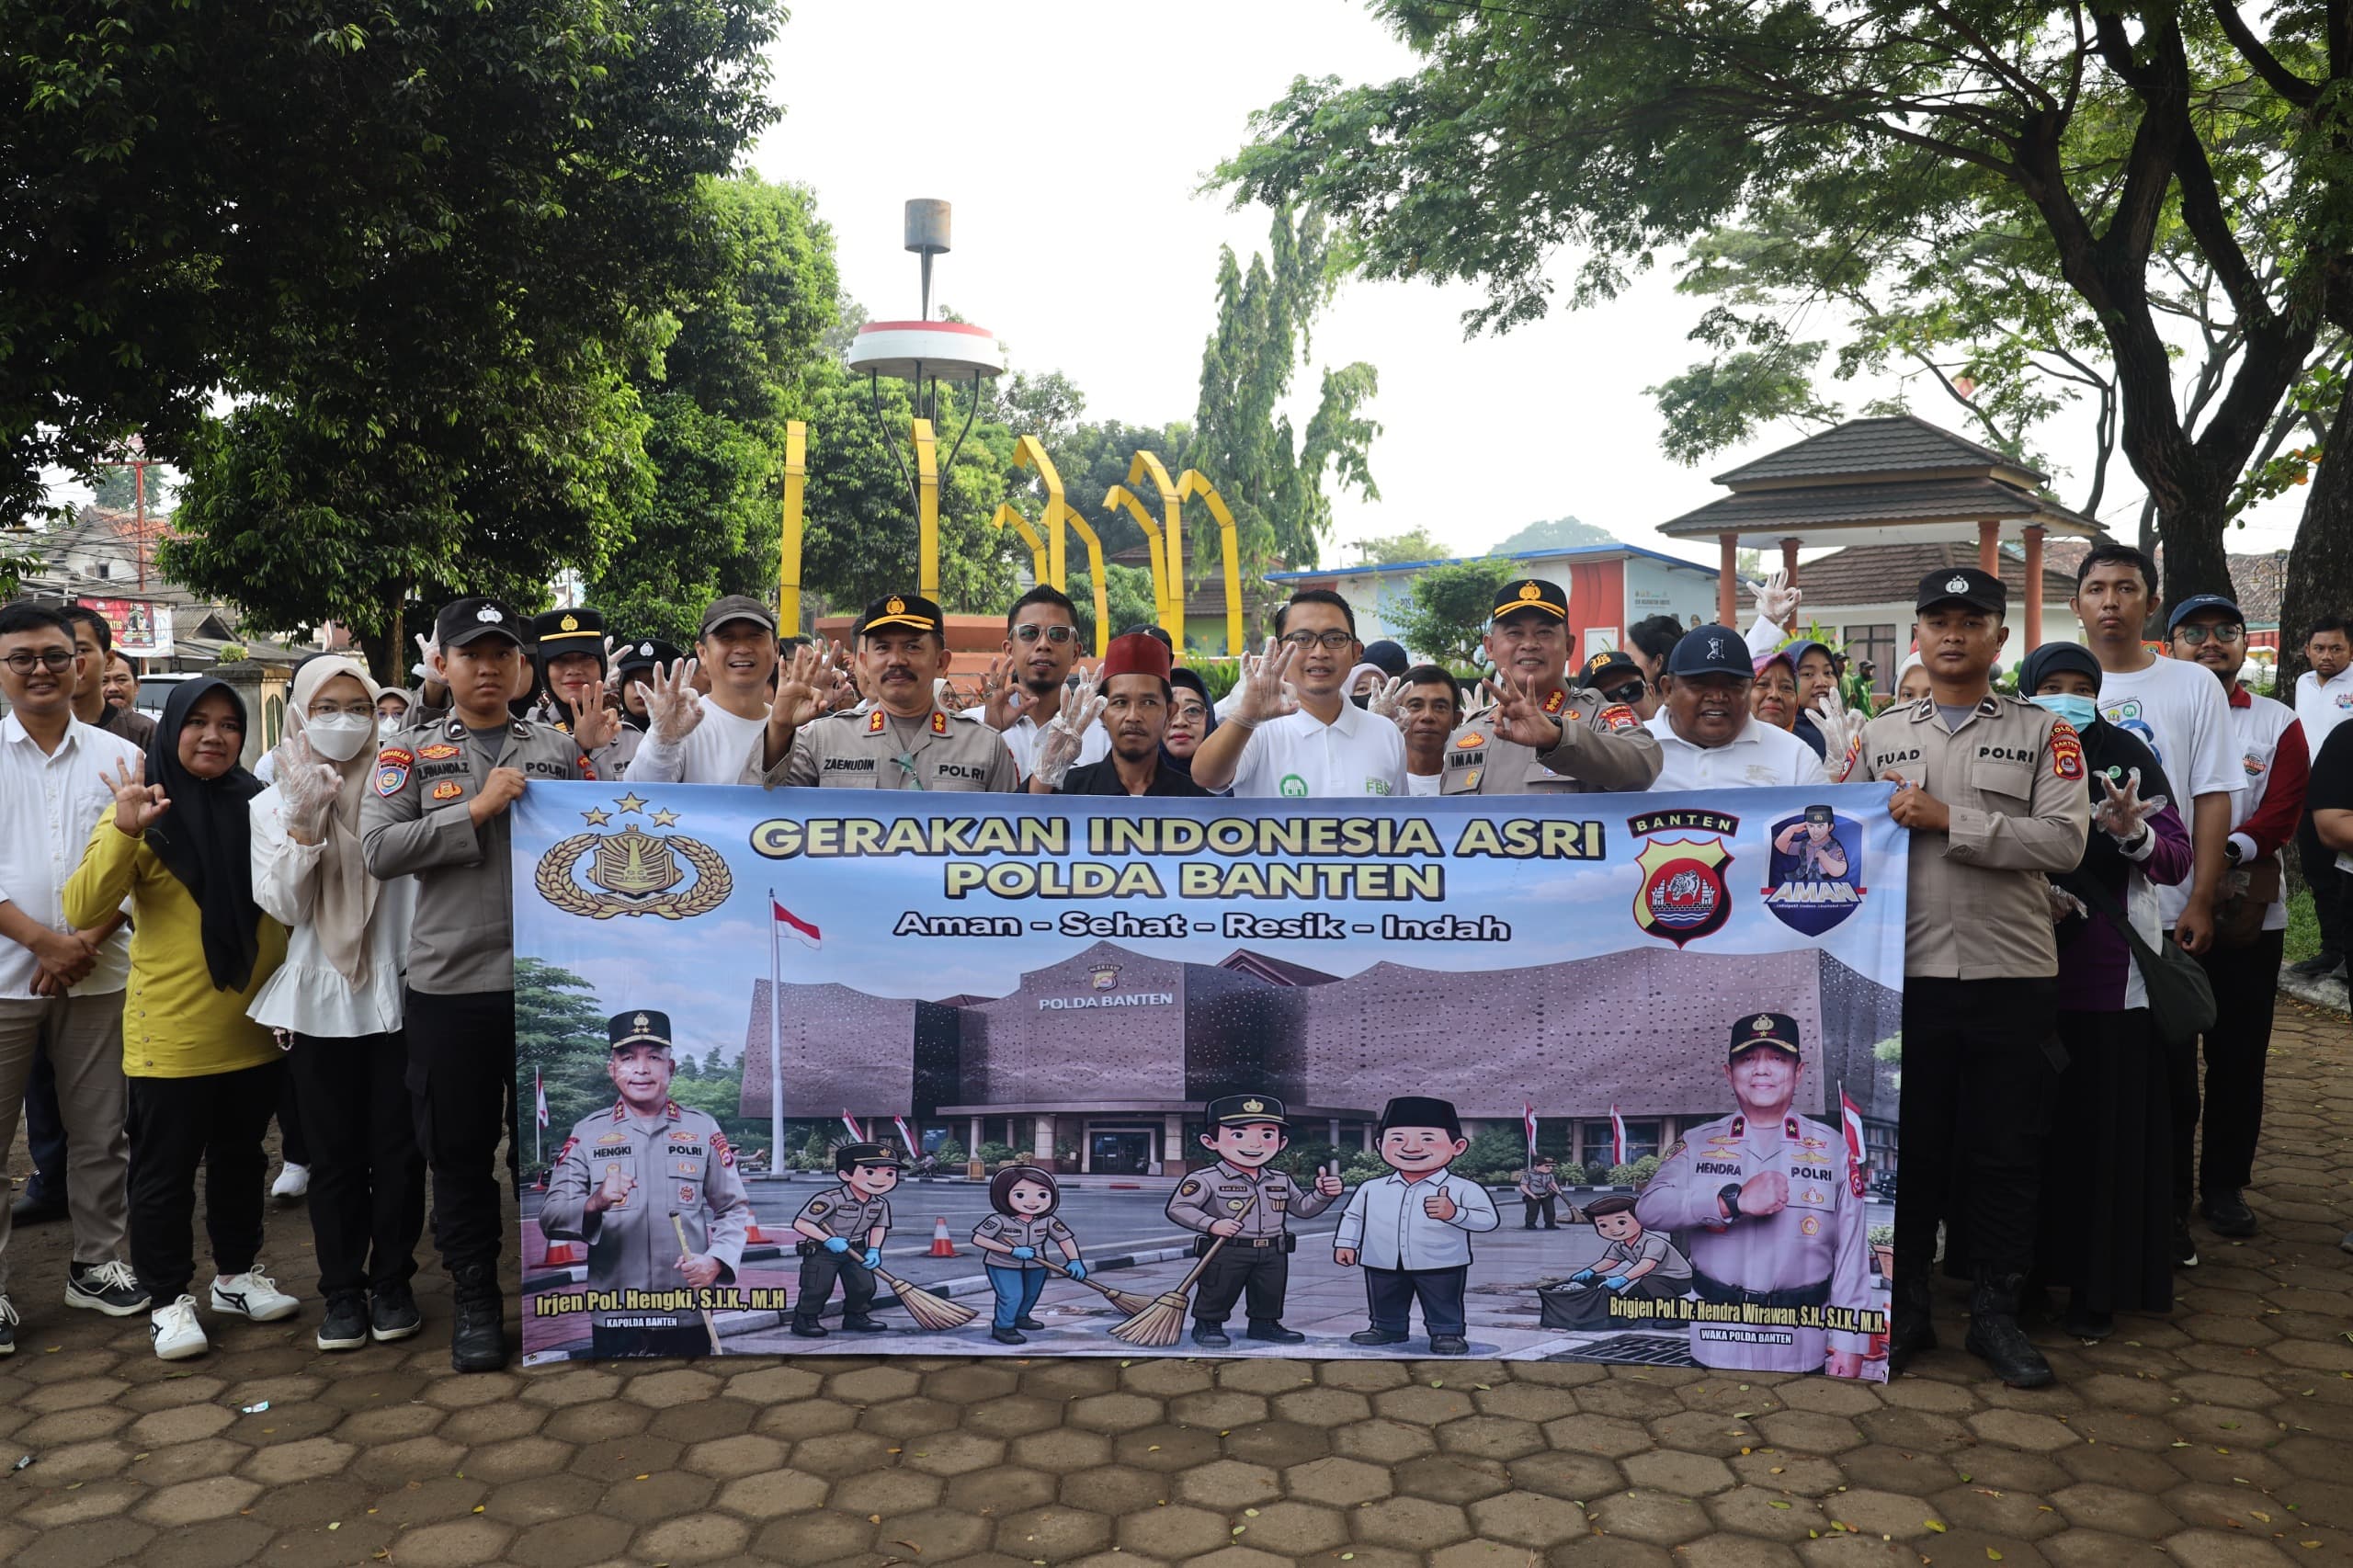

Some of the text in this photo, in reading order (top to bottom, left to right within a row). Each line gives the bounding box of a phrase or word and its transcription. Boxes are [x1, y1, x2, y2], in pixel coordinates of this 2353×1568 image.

[1450, 753, 1483, 767] IMAM
[1877, 749, 1920, 767] FUAD
[1979, 746, 2034, 764] POLRI
[525, 762, 566, 779] POLRI
[824, 758, 875, 771] ZAENUDIN
[938, 764, 985, 780] POLRI
[1636, 812, 1731, 832] BANTEN
[749, 817, 1605, 859] GERAKAN INDONESIA ASRI
[945, 861, 1445, 901] POLDA BANTEN
[1768, 882, 1859, 903] AMAN
[892, 911, 1019, 937] Aman
[1060, 912, 1187, 937] Sehat
[1222, 913, 1345, 939] Resik
[1381, 915, 1511, 940] Indah
[1040, 993, 1173, 1010] POLDA BANTEN
[593, 1145, 631, 1158] HENGKI
[668, 1145, 702, 1156] POLRI
[1696, 1162, 1742, 1176] HENDRA
[1791, 1166, 1832, 1181] POLRI
[535, 1294, 583, 1317] Irjen
[586, 1290, 622, 1312] Pol.
[625, 1289, 698, 1312] Hengki,
[750, 1289, 787, 1311] M.H
[607, 1317, 677, 1328] KAPOLDA BANTEN
[1609, 1296, 1886, 1333] Brigjen Pol. Dr. Hendra Wirawan, S.H., S.I.K., M.H.
[1701, 1329, 1791, 1344] WAKA POLDA BANTEN
